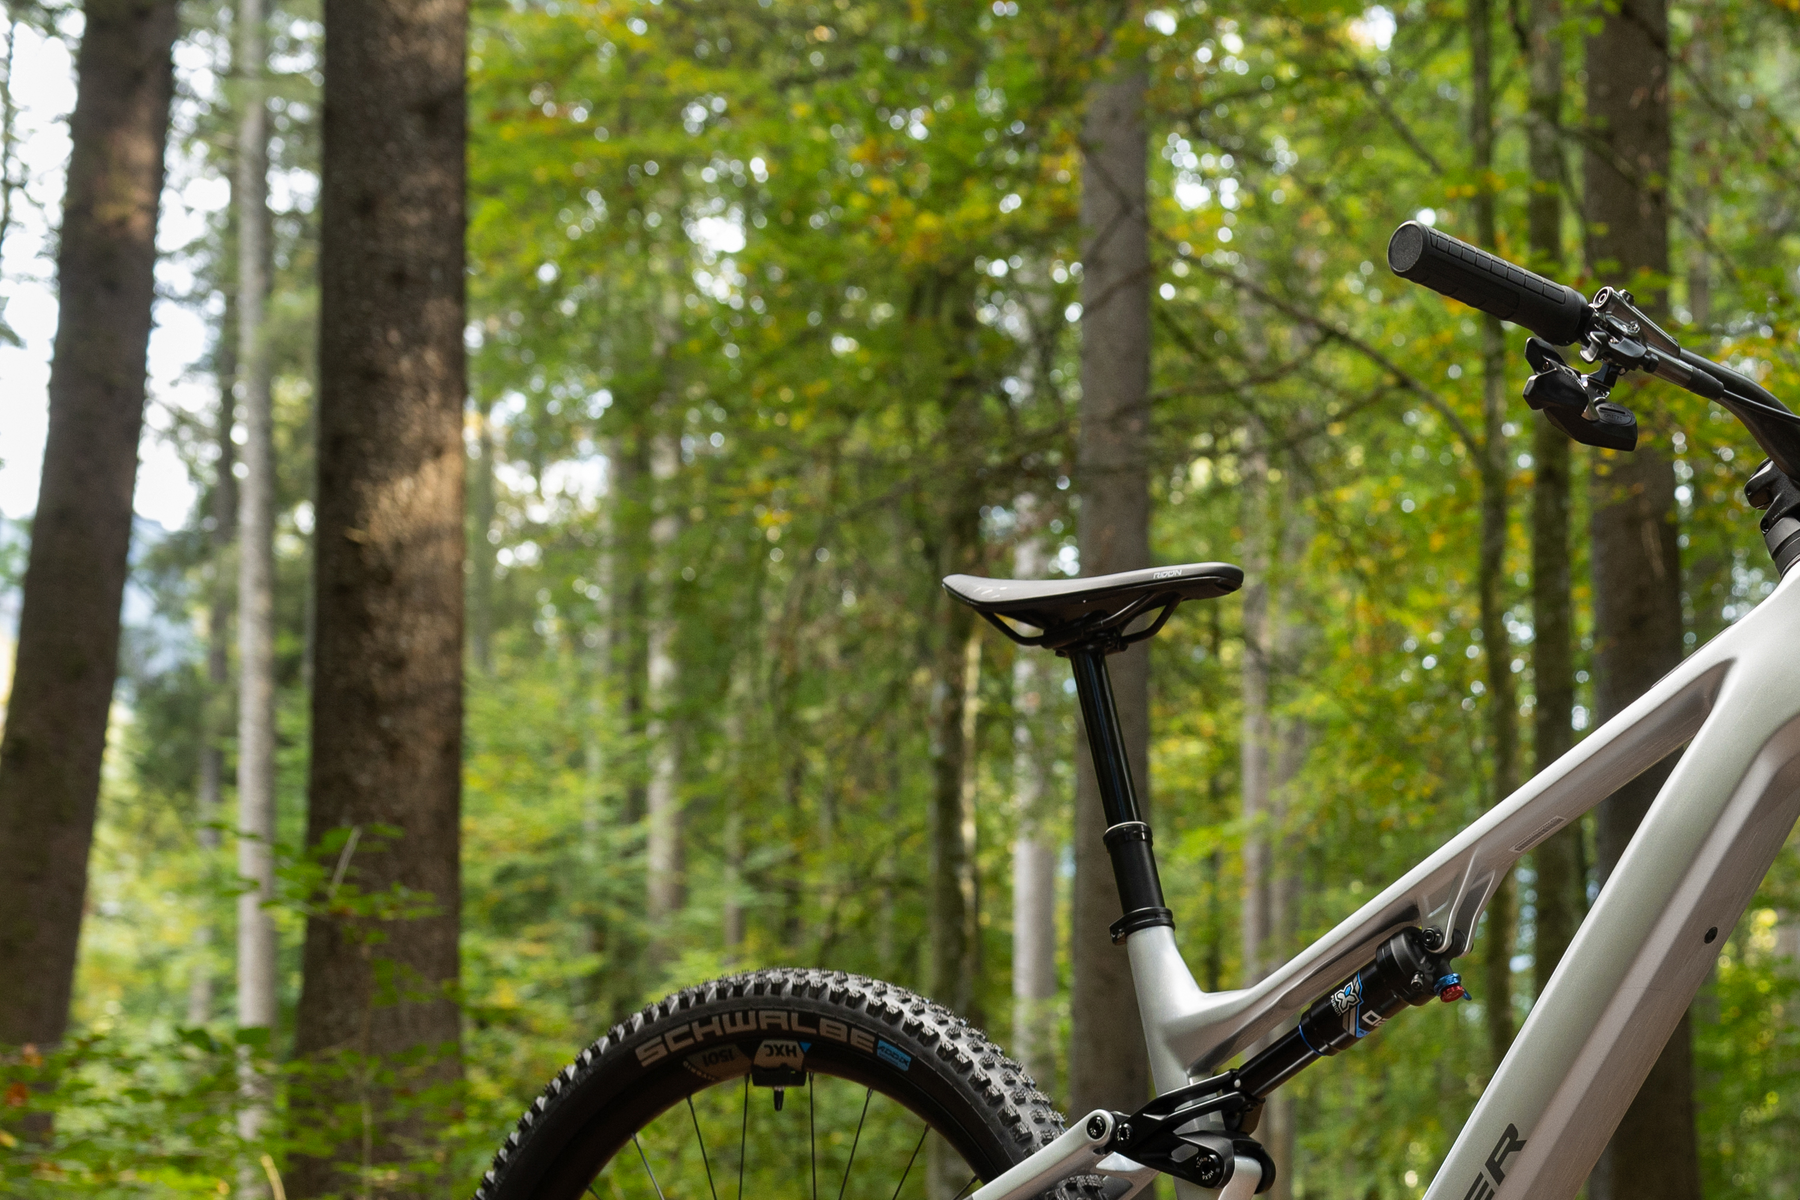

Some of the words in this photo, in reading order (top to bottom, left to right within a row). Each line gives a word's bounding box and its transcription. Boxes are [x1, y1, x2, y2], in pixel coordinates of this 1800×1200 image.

[634, 1009, 875, 1068] SCHWALBE
[702, 1048, 735, 1067] 1501
[763, 1043, 798, 1058] HXC
